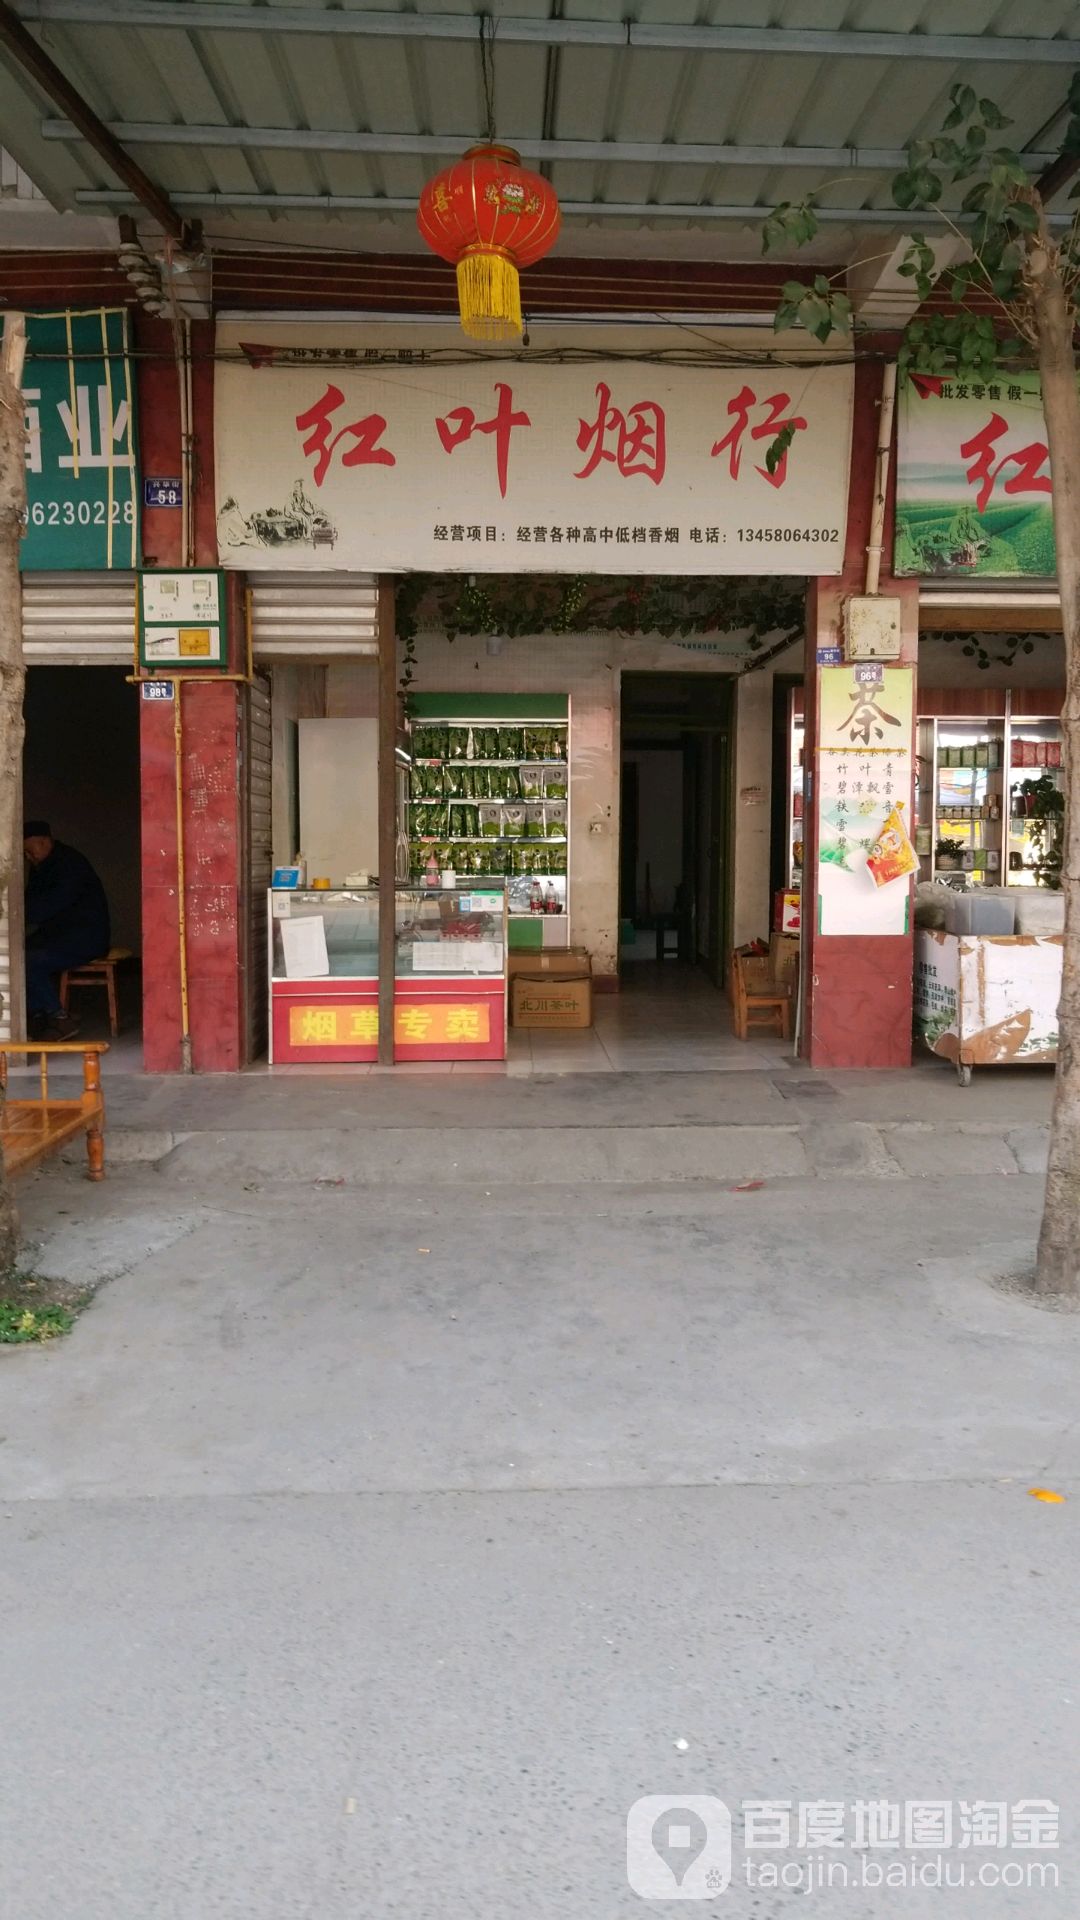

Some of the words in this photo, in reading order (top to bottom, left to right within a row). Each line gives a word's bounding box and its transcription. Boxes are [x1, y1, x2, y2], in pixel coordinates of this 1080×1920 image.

[942, 384, 1002, 400] 批发零售
[1007, 385, 1042, 400] 假一
[295, 382, 808, 499] 红叶烟行
[960, 411, 1053, 514] 红
[158, 490, 177, 504] 58
[836, 683, 902, 746] 茶
[836, 762, 894, 777] 竹叶青
[837, 781, 894, 795] 碧潭飘雪
[835, 799, 894, 814] 铁音
[519, 1000, 579, 1012] 北川茶叶
[302, 1008, 480, 1041] 烟草专卖
